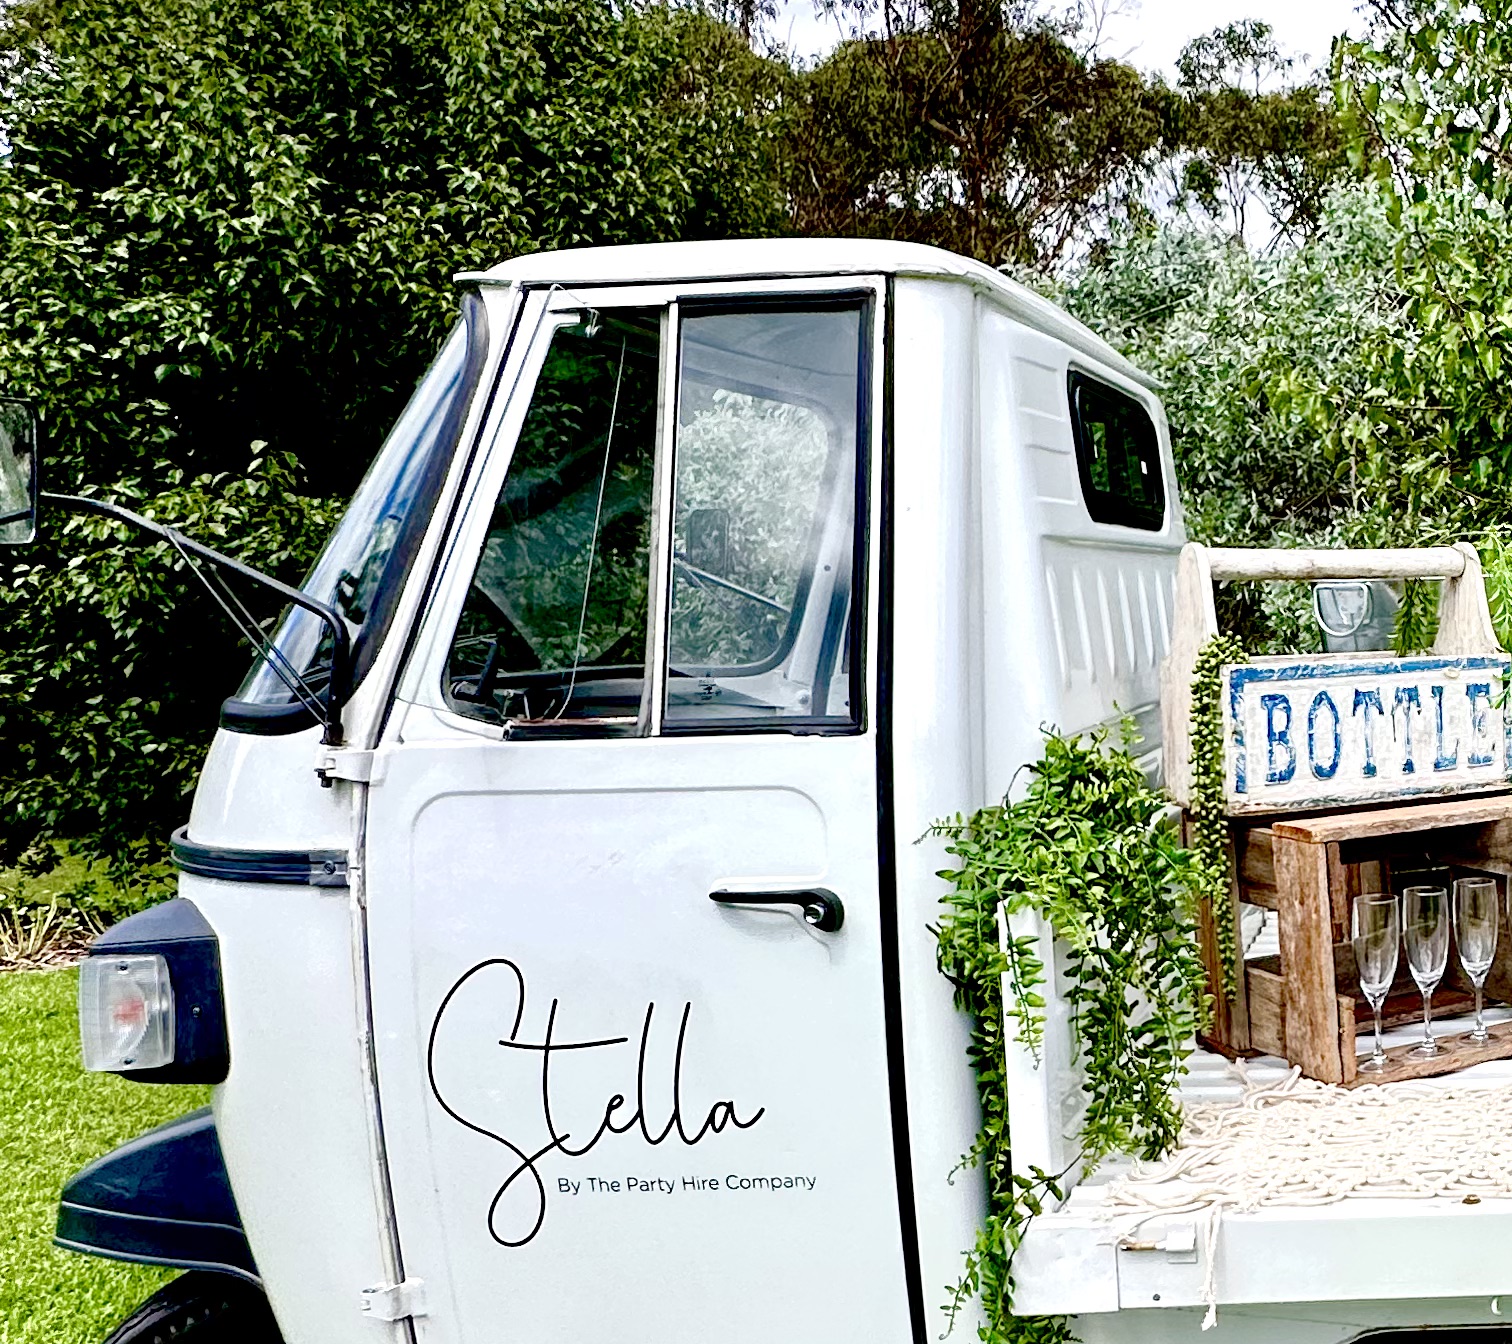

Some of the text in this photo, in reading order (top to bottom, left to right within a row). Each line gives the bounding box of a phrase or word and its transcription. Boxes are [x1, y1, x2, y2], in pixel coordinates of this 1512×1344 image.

[1261, 683, 1497, 787] BOTTLE
[427, 958, 766, 1248] Stella
[558, 1173, 816, 1195] By The Party Hire Company
